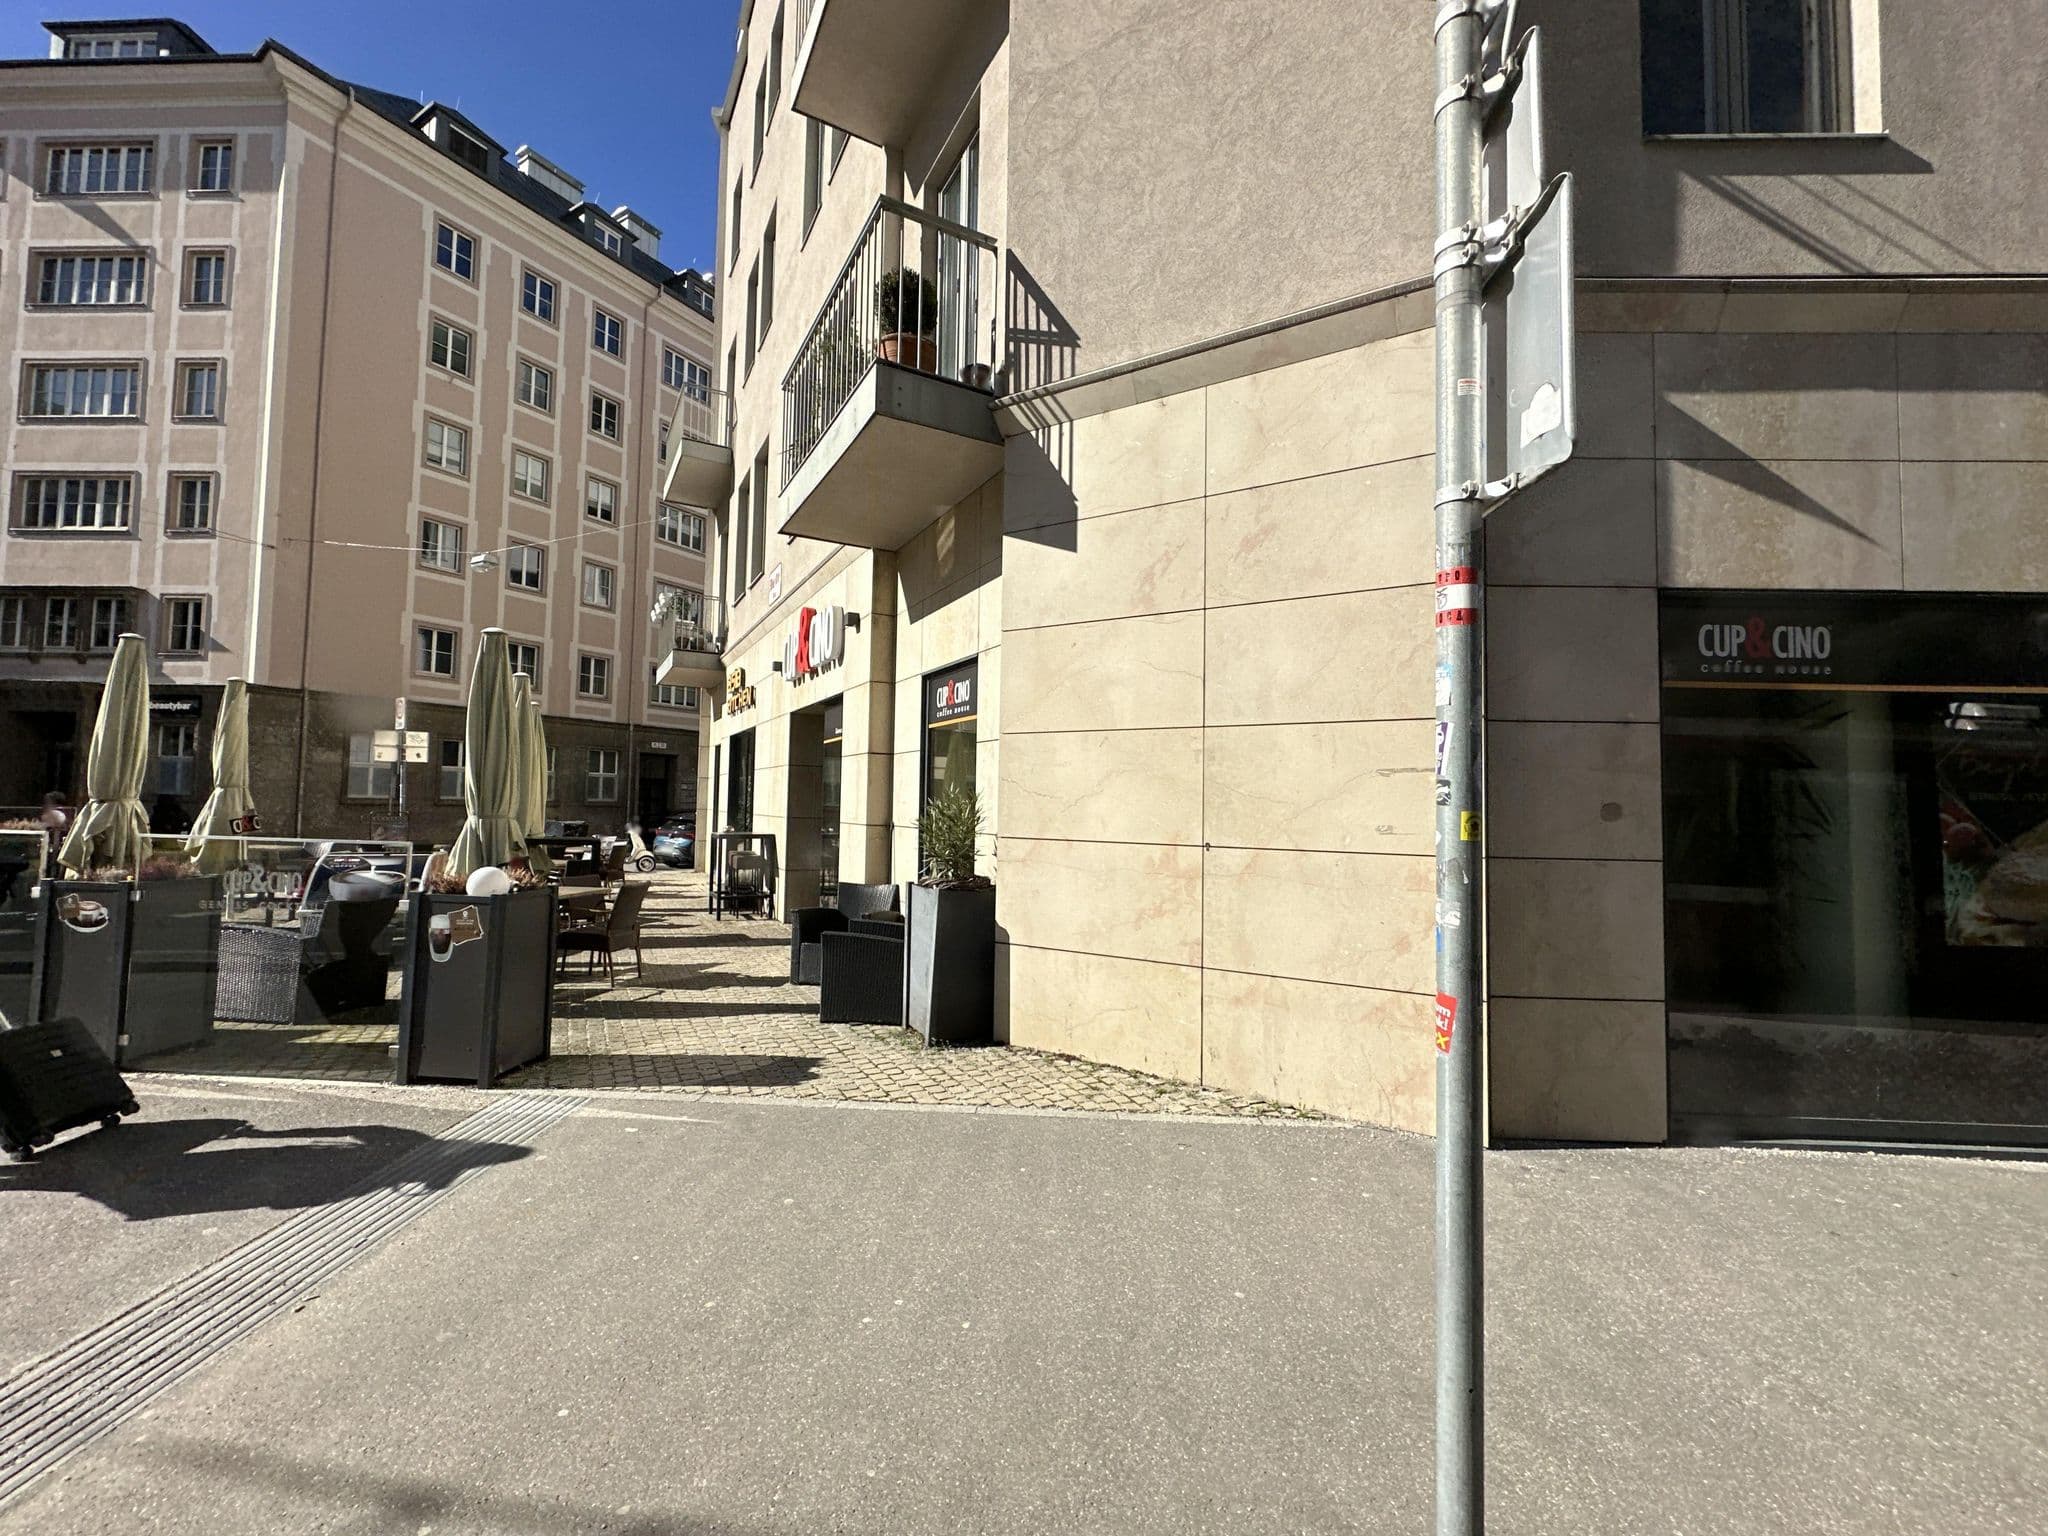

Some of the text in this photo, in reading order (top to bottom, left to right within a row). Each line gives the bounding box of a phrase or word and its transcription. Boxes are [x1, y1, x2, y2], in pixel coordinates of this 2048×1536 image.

[1698, 615, 1831, 660] CUP&CINO
[1701, 659, 1764, 673] coffee
[936, 679, 971, 708] CUP&CINO
